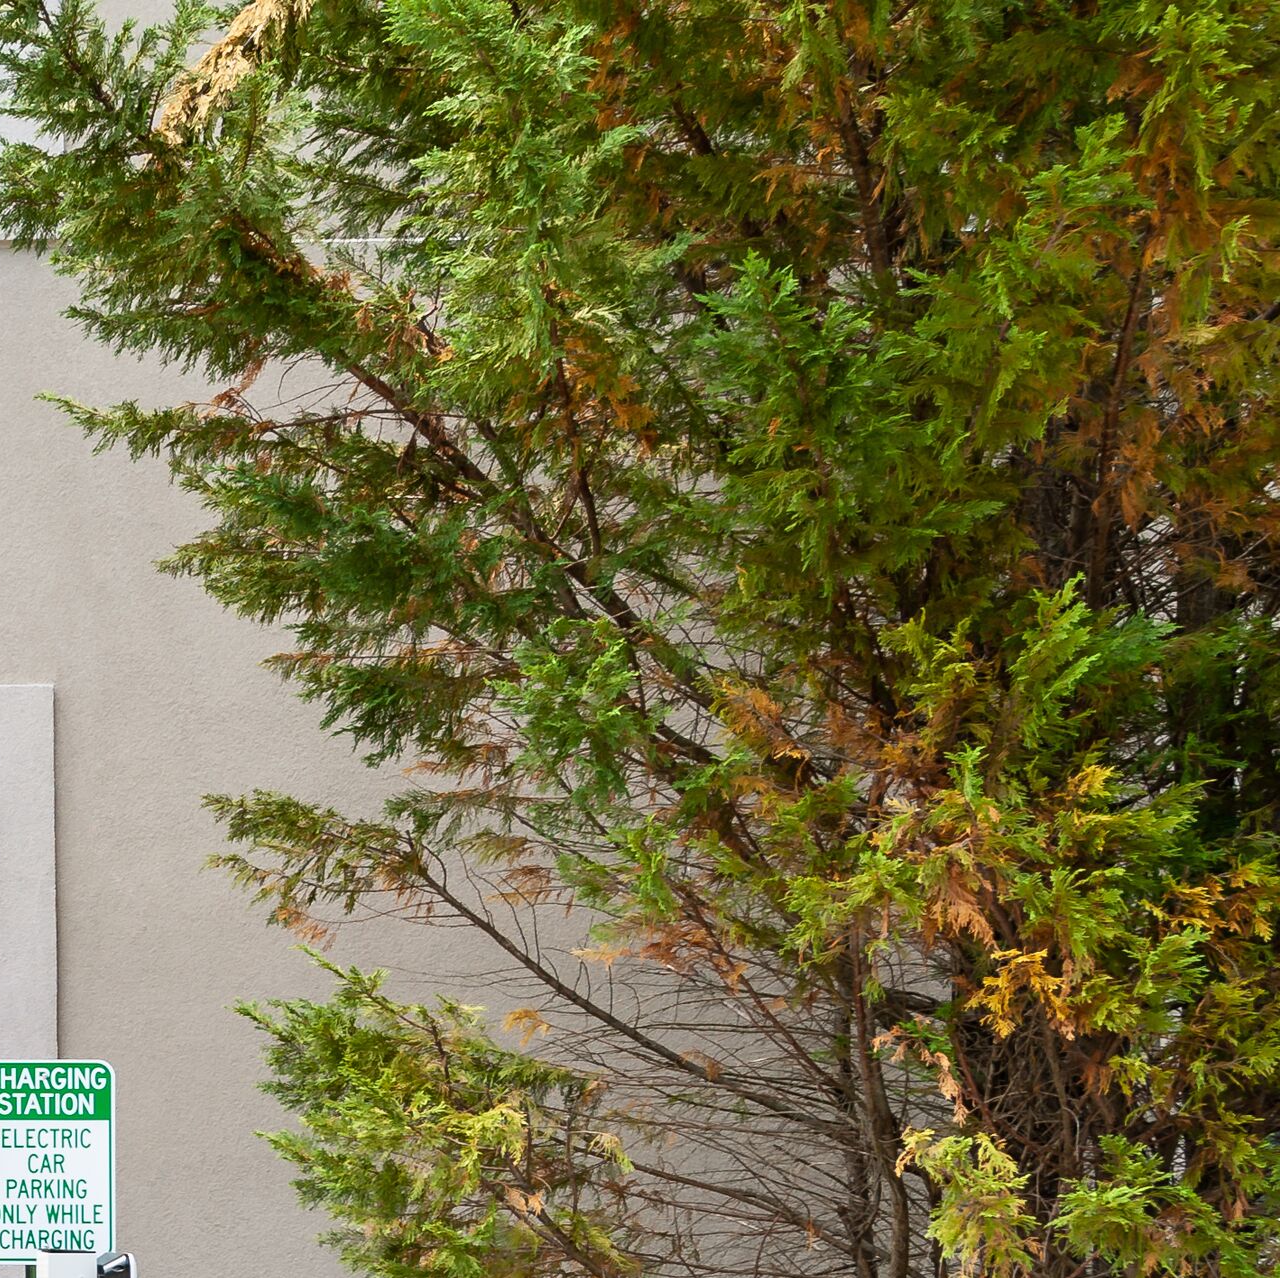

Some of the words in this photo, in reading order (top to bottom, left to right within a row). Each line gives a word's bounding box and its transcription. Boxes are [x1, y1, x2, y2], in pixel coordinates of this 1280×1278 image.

[1, 1128, 92, 1149] ELECTRIC
[27, 1153, 65, 1174] CAR
[6, 1179, 88, 1199] PARKING
[46, 1204, 104, 1224] WHILE
[0, 1229, 96, 1250] CHARGING
